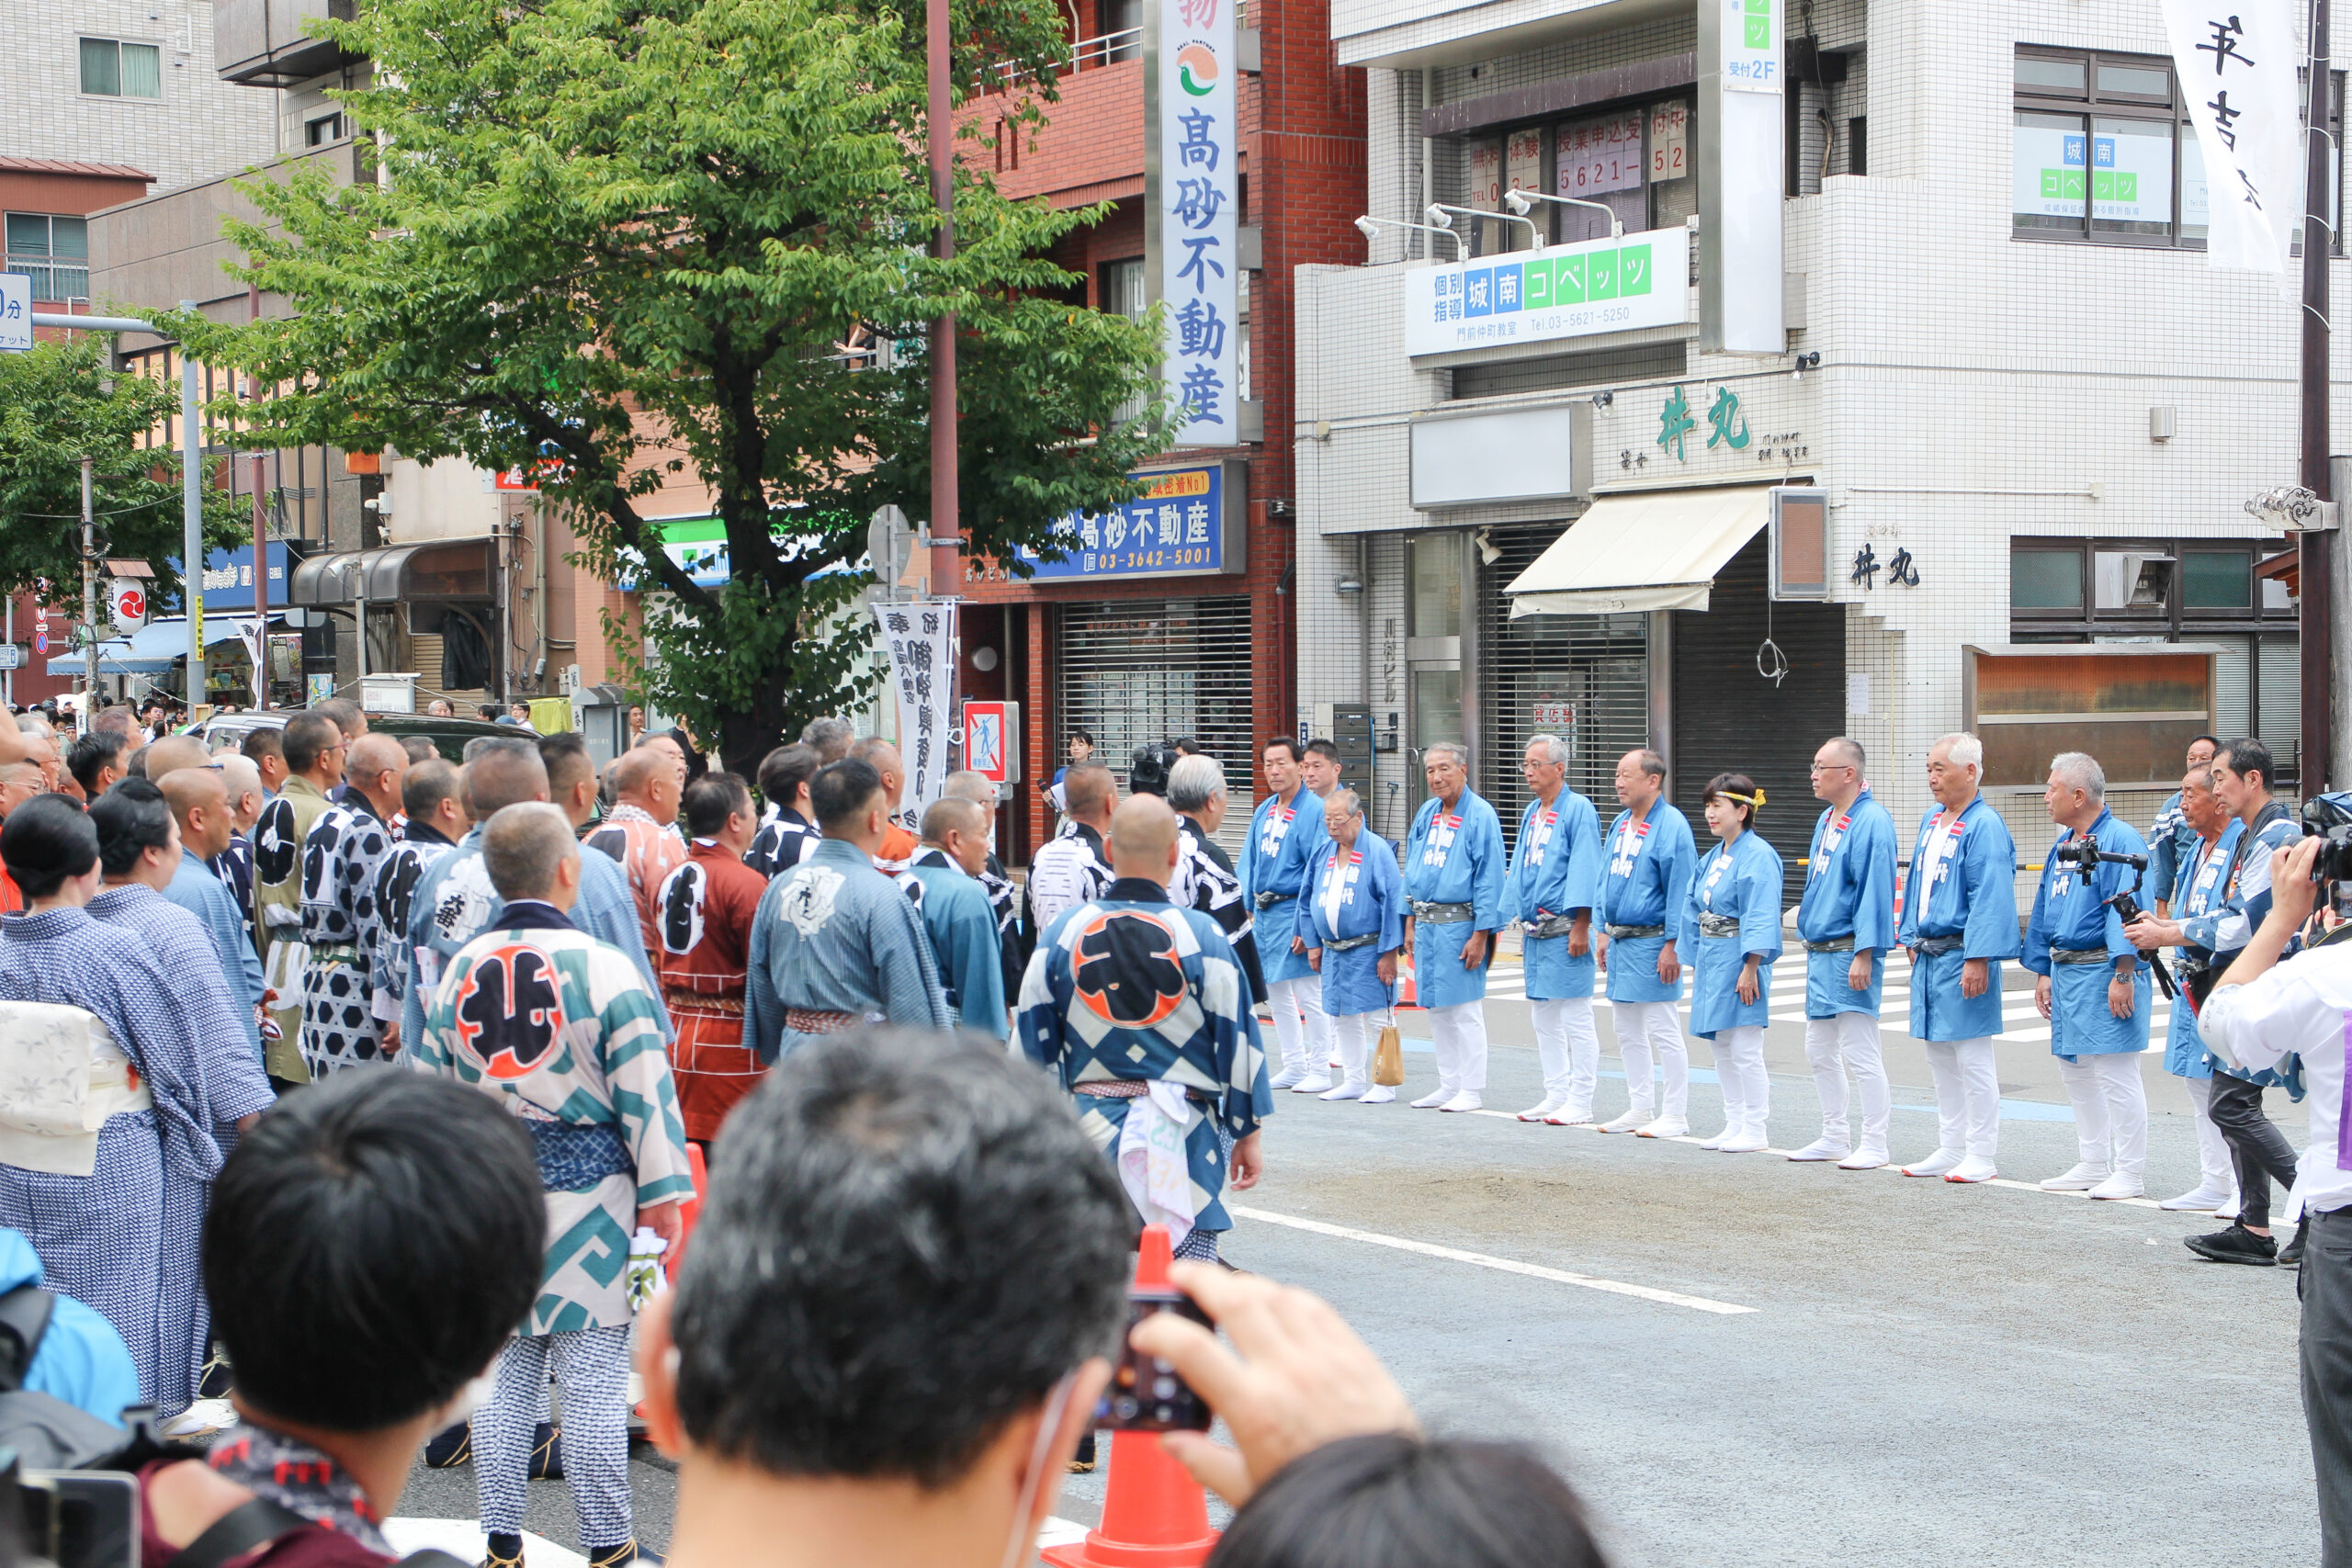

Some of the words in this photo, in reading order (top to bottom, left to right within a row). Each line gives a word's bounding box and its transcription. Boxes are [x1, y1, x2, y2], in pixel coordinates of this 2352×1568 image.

[2067, 141, 2112, 163] 城南
[1472, 190, 1486, 203] TEL
[1457, 321, 1517, 343] 門前仲町教室
[1100, 547, 1211, 570] 03-3642-5001
